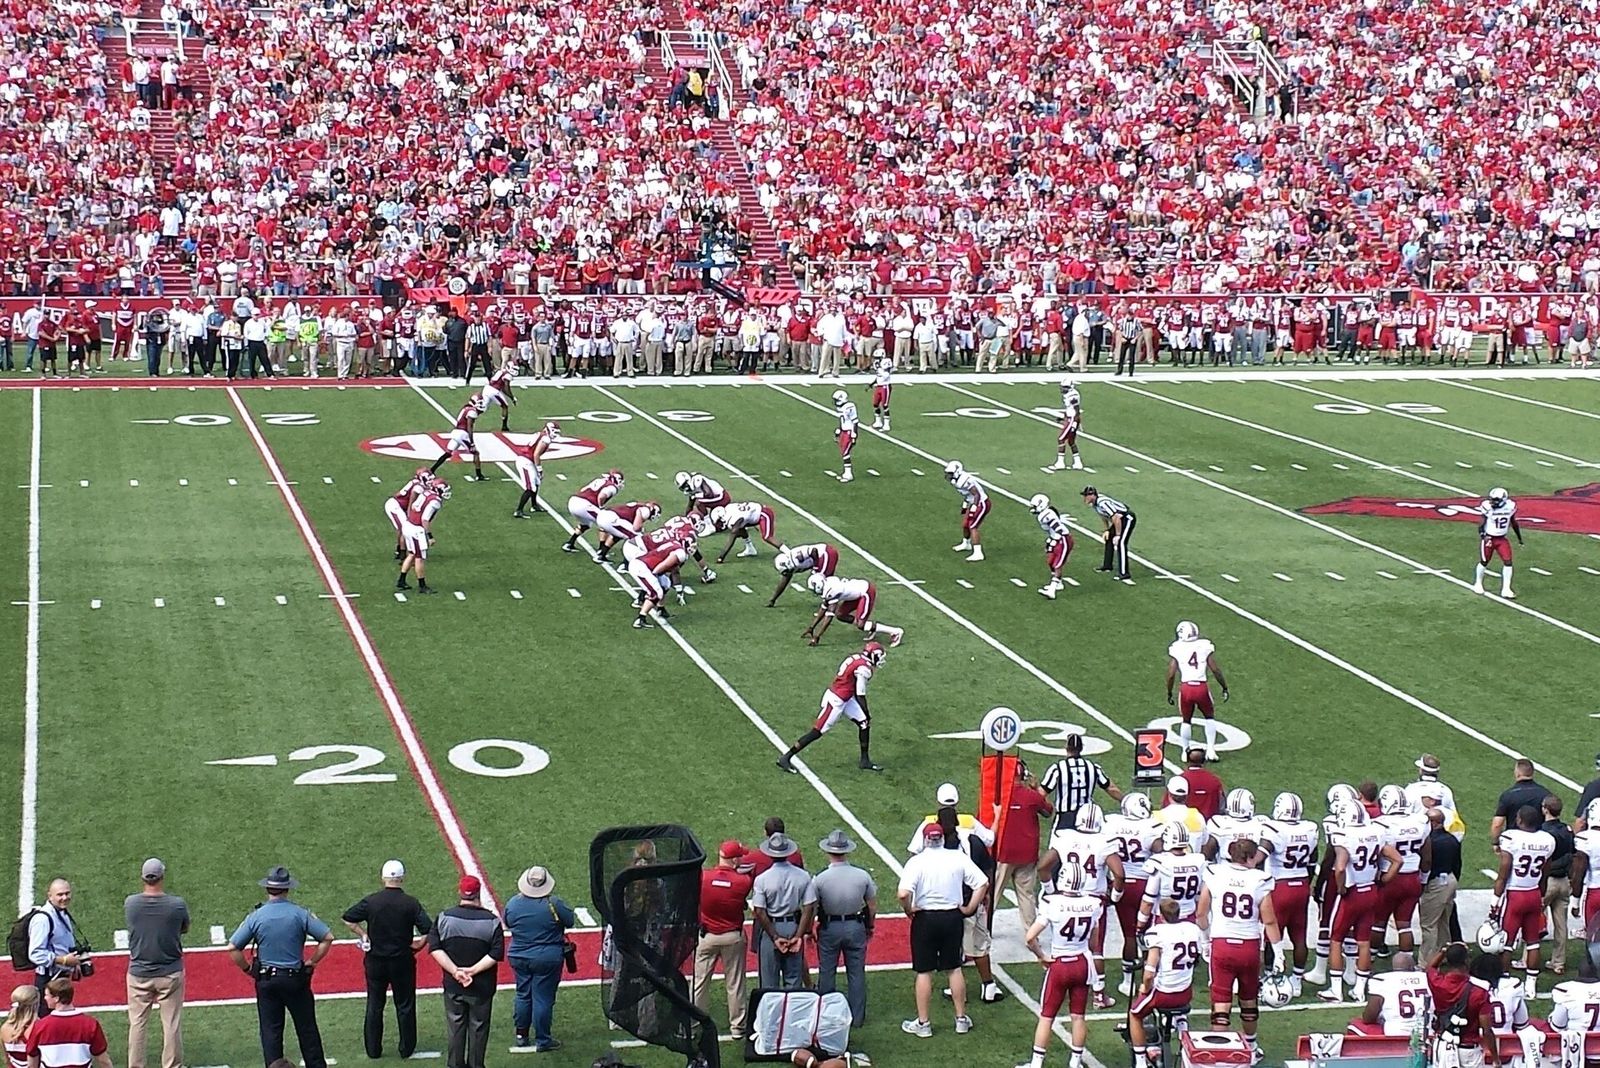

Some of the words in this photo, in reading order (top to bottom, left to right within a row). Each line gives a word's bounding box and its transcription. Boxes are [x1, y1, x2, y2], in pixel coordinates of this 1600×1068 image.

[1494, 517, 1508, 530] 12
[1187, 651, 1199, 670] 4
[992, 717, 1016, 742] SEC
[1138, 733, 1164, 768] 3
[1283, 844, 1310, 869] 52
[1514, 854, 1546, 878] 33
[1170, 875, 1200, 900] 58
[1222, 891, 1254, 920] 83
[1060, 916, 1092, 942] 47
[1172, 941, 1199, 970] 29
